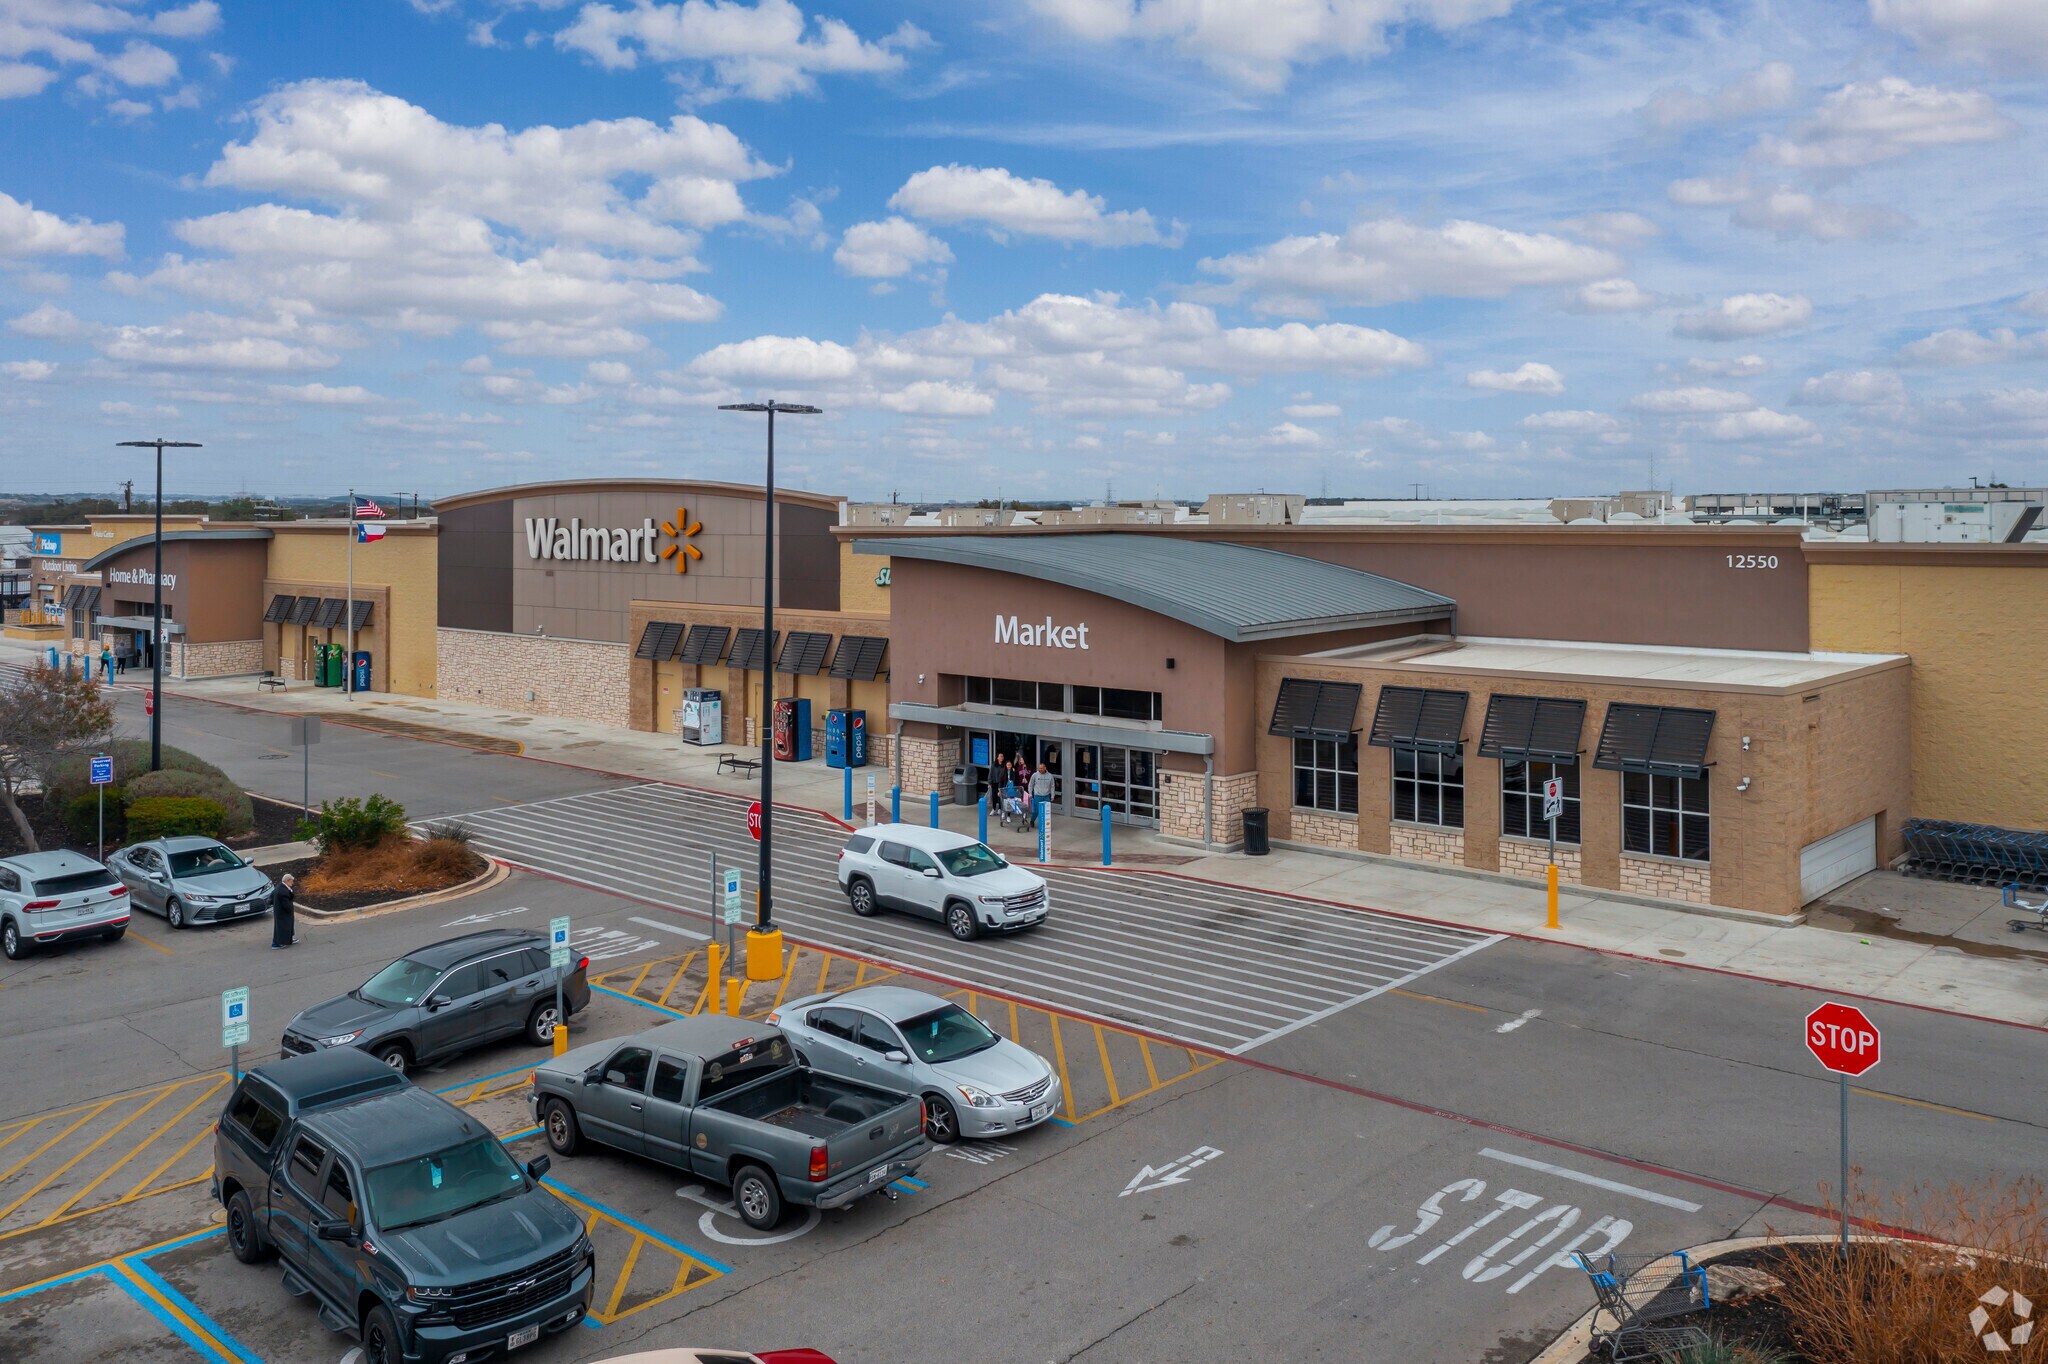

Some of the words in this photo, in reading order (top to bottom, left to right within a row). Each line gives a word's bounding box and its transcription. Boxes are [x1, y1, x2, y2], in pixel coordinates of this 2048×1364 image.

[42, 538, 57, 553] Pickup
[525, 517, 658, 564] Walmart
[42, 560, 62, 572] Outdoor
[62, 561, 77, 575] Living
[1726, 553, 1779, 570] 12550
[110, 568, 131, 582] Home
[132, 569, 138, 583] &
[139, 569, 177, 591] Pharacy
[994, 614, 1089, 650] Market
[855, 732, 863, 758] pepsi
[1811, 1020, 1876, 1057] STOP
[1368, 1178, 1634, 1295] STOP
